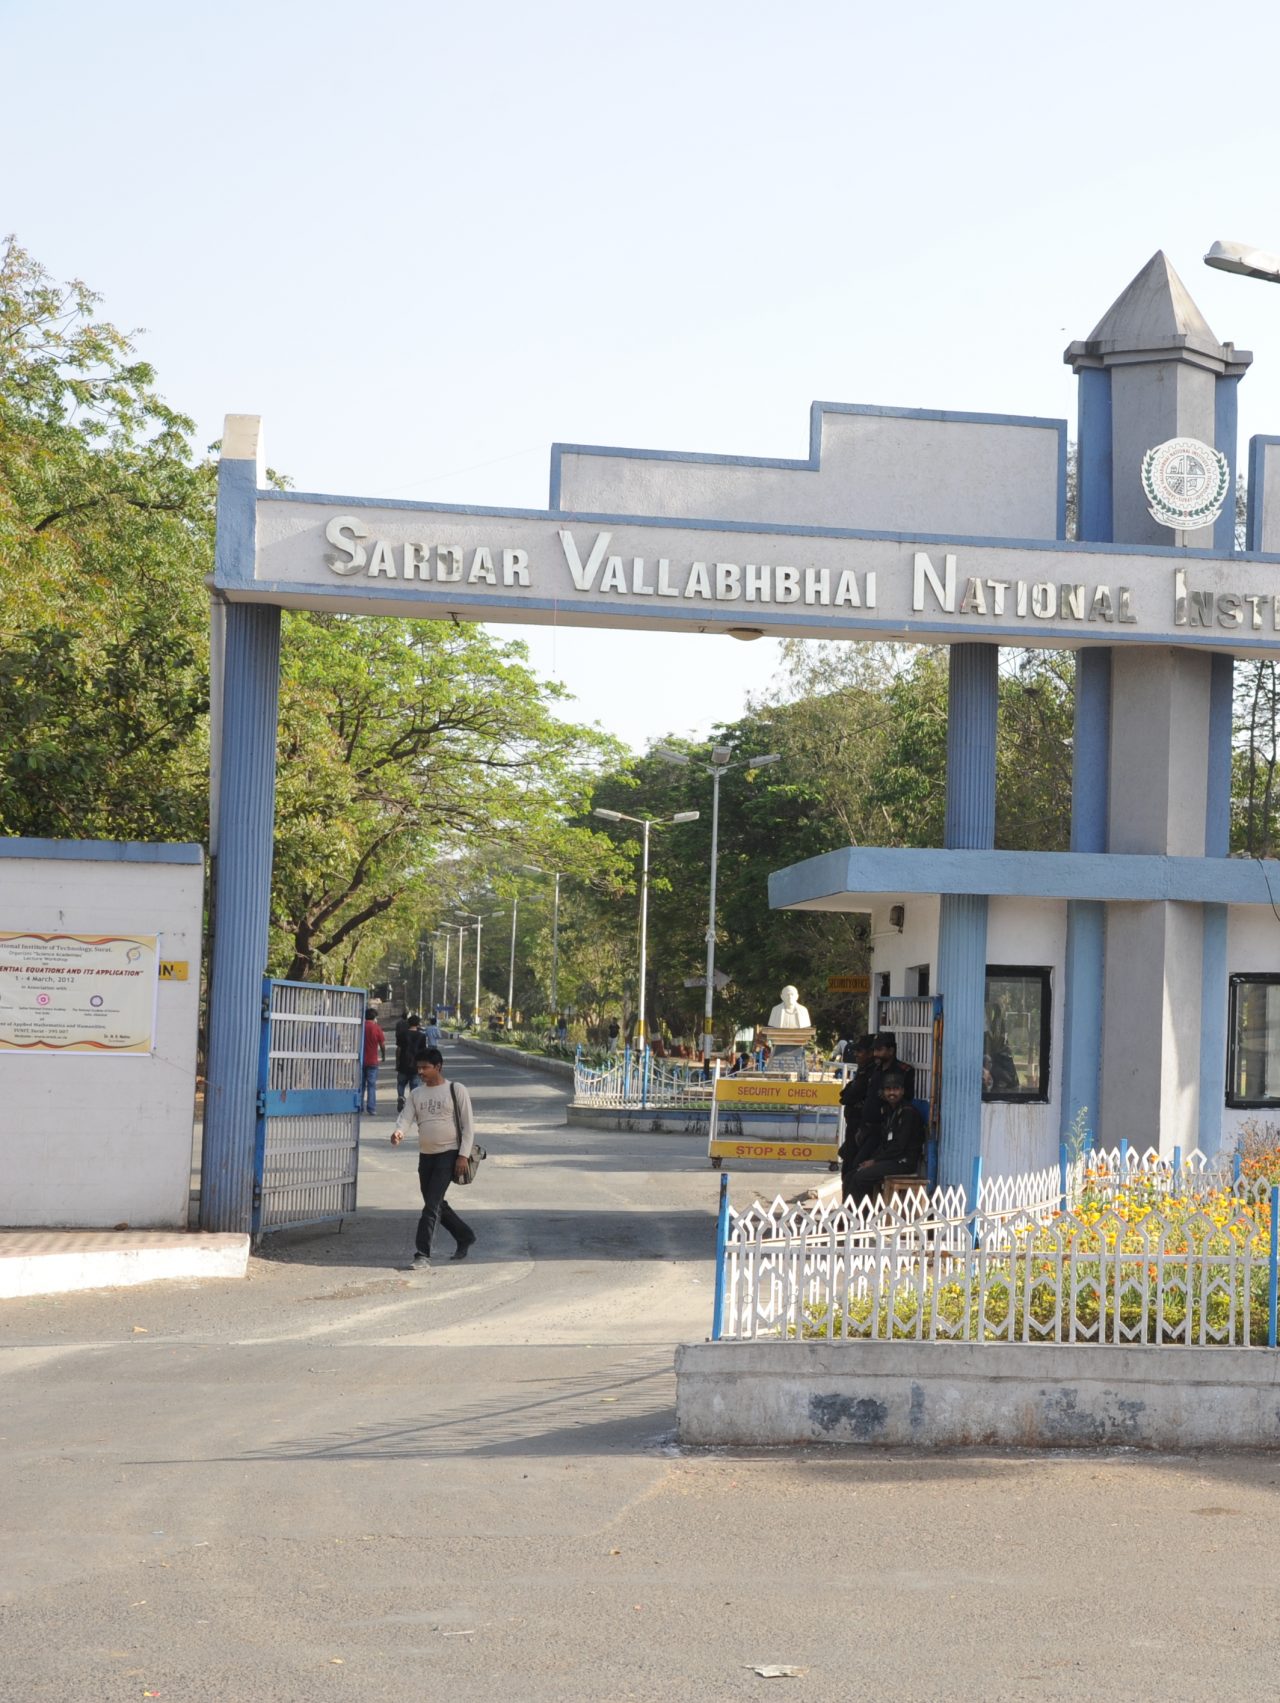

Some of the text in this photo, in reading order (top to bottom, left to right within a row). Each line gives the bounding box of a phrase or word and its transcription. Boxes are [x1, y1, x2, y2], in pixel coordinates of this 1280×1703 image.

[325, 516, 531, 586] SARDAR
[558, 530, 876, 608] VALLABHBHAI
[913, 552, 1138, 624] NATIONAL
[738, 1087, 817, 1098] SECURITY CHECK
[736, 1146, 812, 1157] STOP & GO
